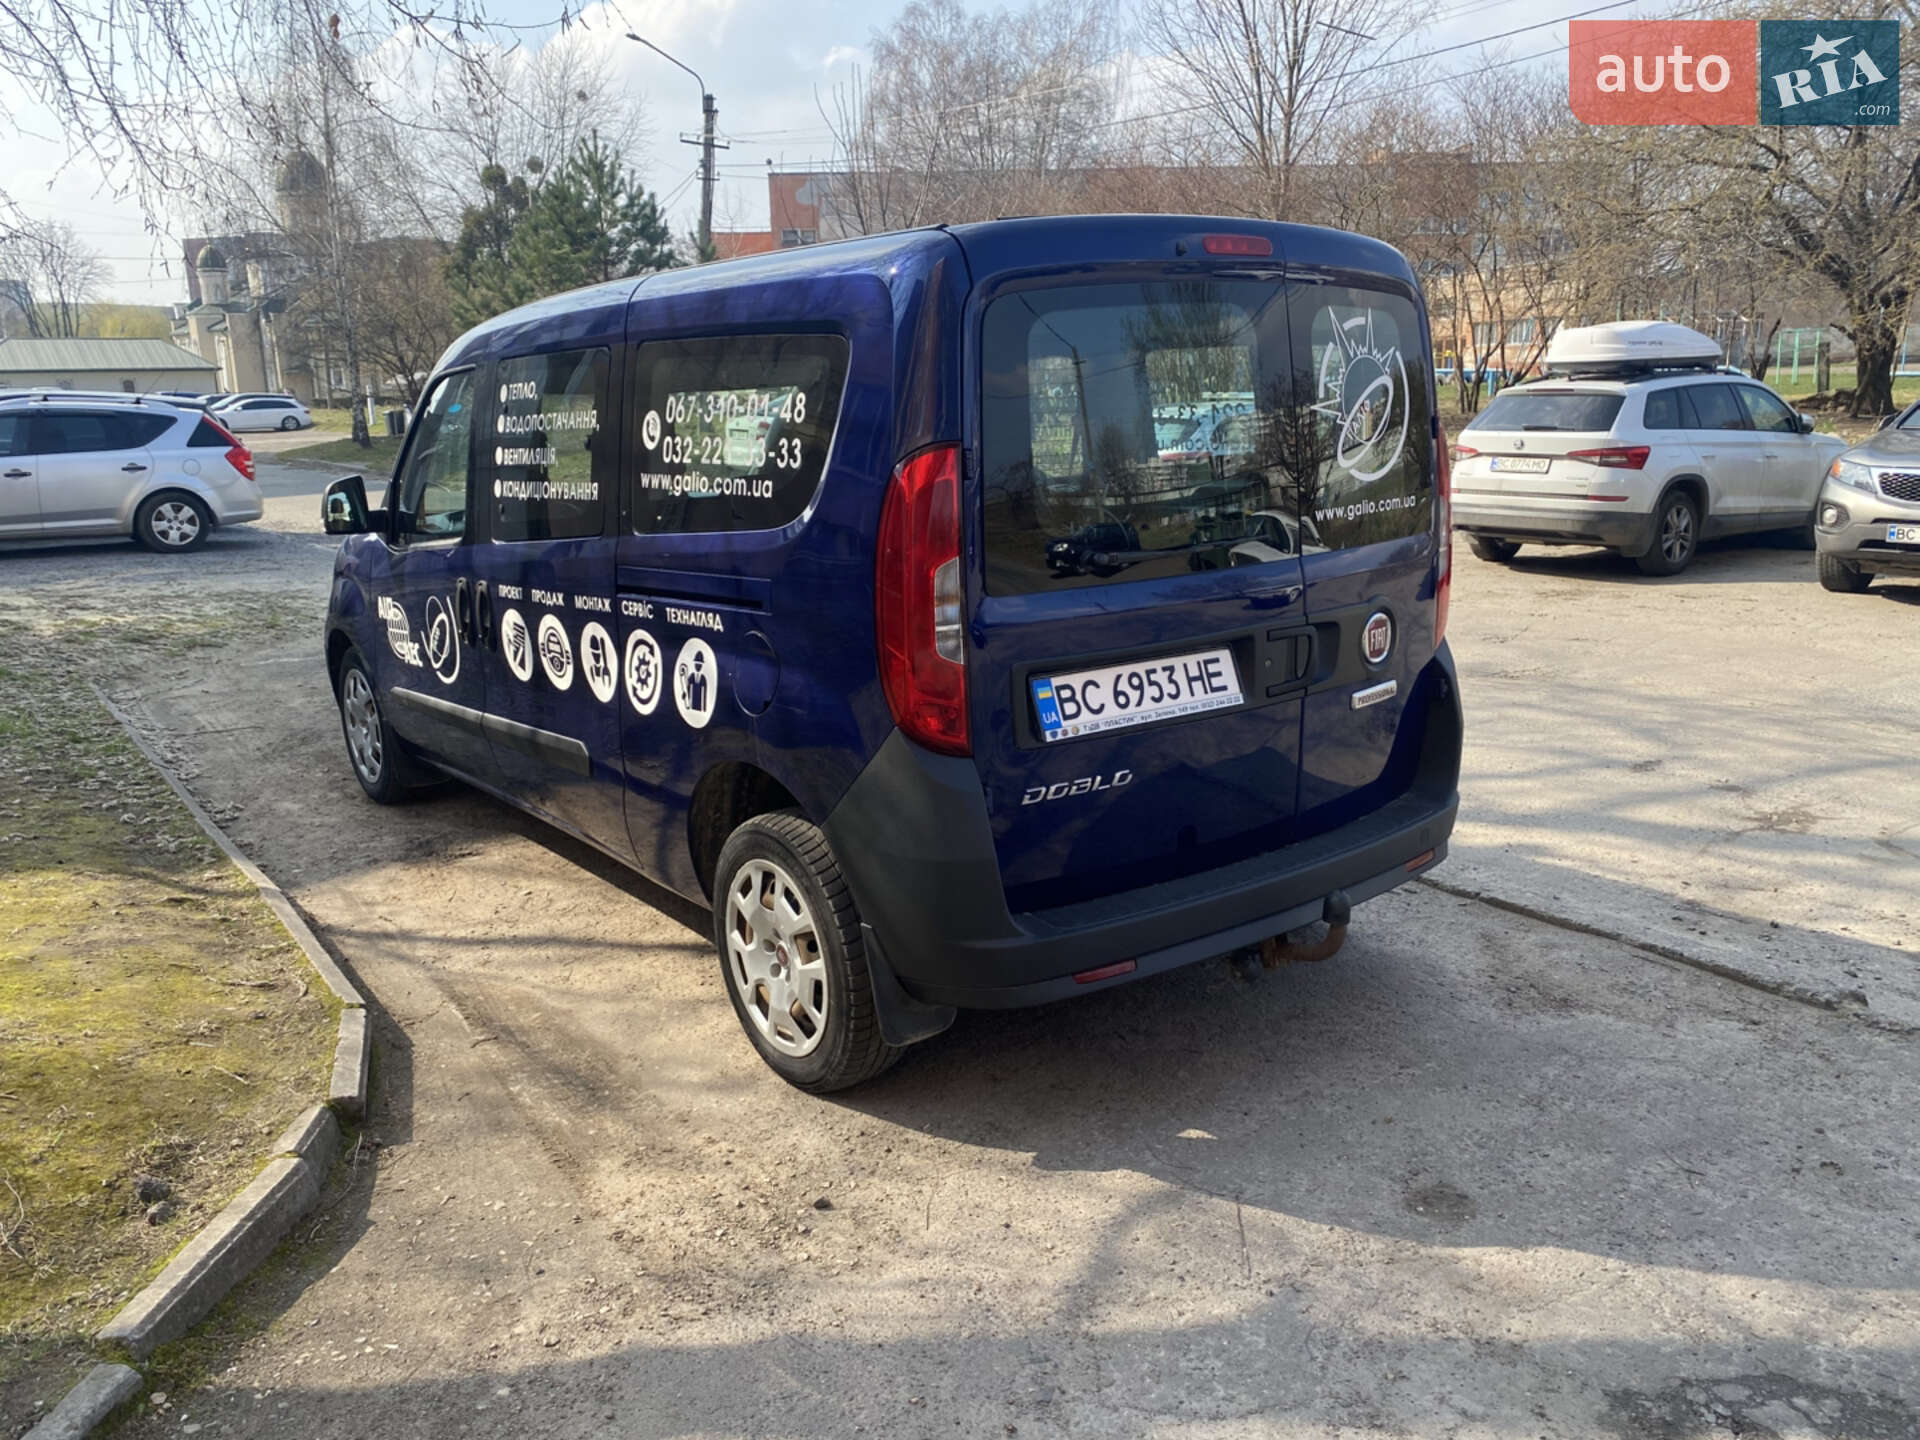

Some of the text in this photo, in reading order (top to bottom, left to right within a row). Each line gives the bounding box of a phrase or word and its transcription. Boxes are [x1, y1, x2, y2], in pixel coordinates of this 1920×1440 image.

[502, 480, 599, 501] КОНДИЦІОНУВАННЯ
[640, 471, 774, 498] www.galio.com.ua
[1315, 495, 1416, 521] www.galio.com.ua
[498, 584, 724, 632] ПРОЕКТ ПРОДАЖ МОНТАЖ СЕРВІС ТЕХНАГЛЯД
[1370, 626, 1388, 652] FIAT
[1054, 657, 1228, 721] BC 6953 HE
[1043, 712, 1059, 724] UA
[1022, 769, 1133, 806] DOBLO
